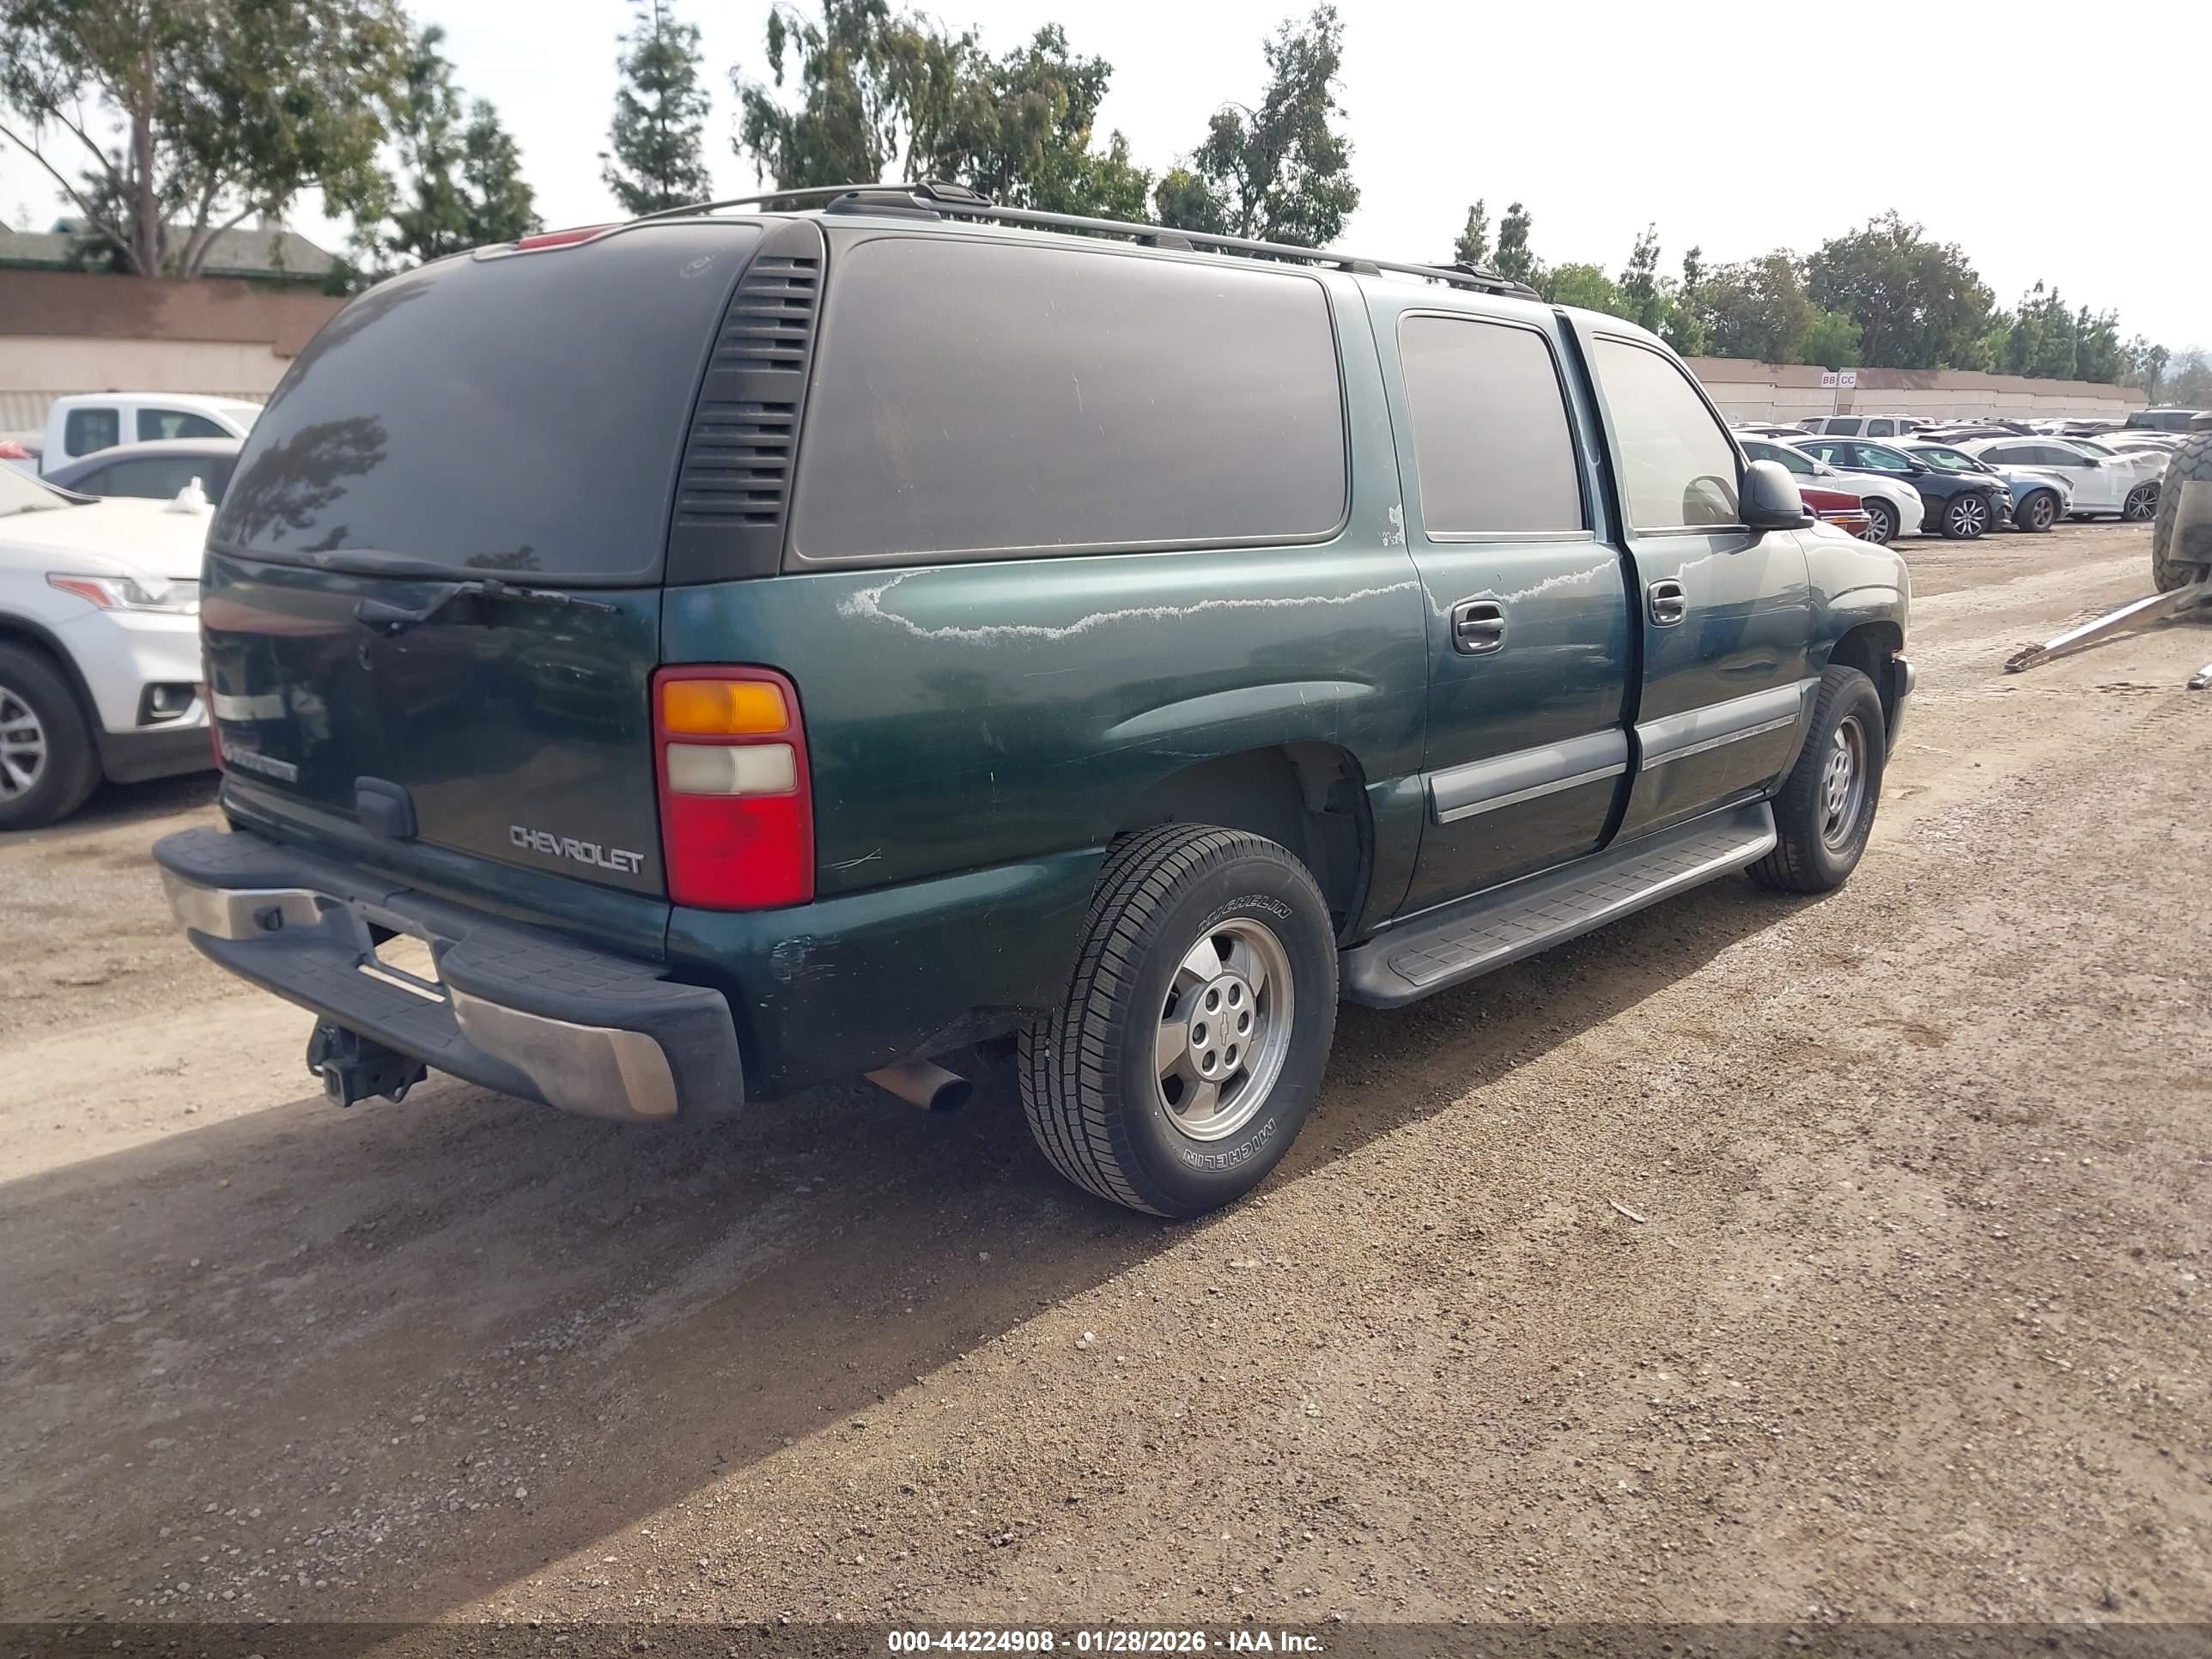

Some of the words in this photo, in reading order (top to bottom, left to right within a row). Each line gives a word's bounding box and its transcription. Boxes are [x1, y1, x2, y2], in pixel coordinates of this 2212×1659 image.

[1823, 376, 1836, 385] BB
[1841, 376, 1855, 385] CC
[509, 825, 645, 874] CHEVROLET
[1196, 894, 1292, 938] MICHELIN
[1182, 1118, 1277, 1169] MICHELIN
